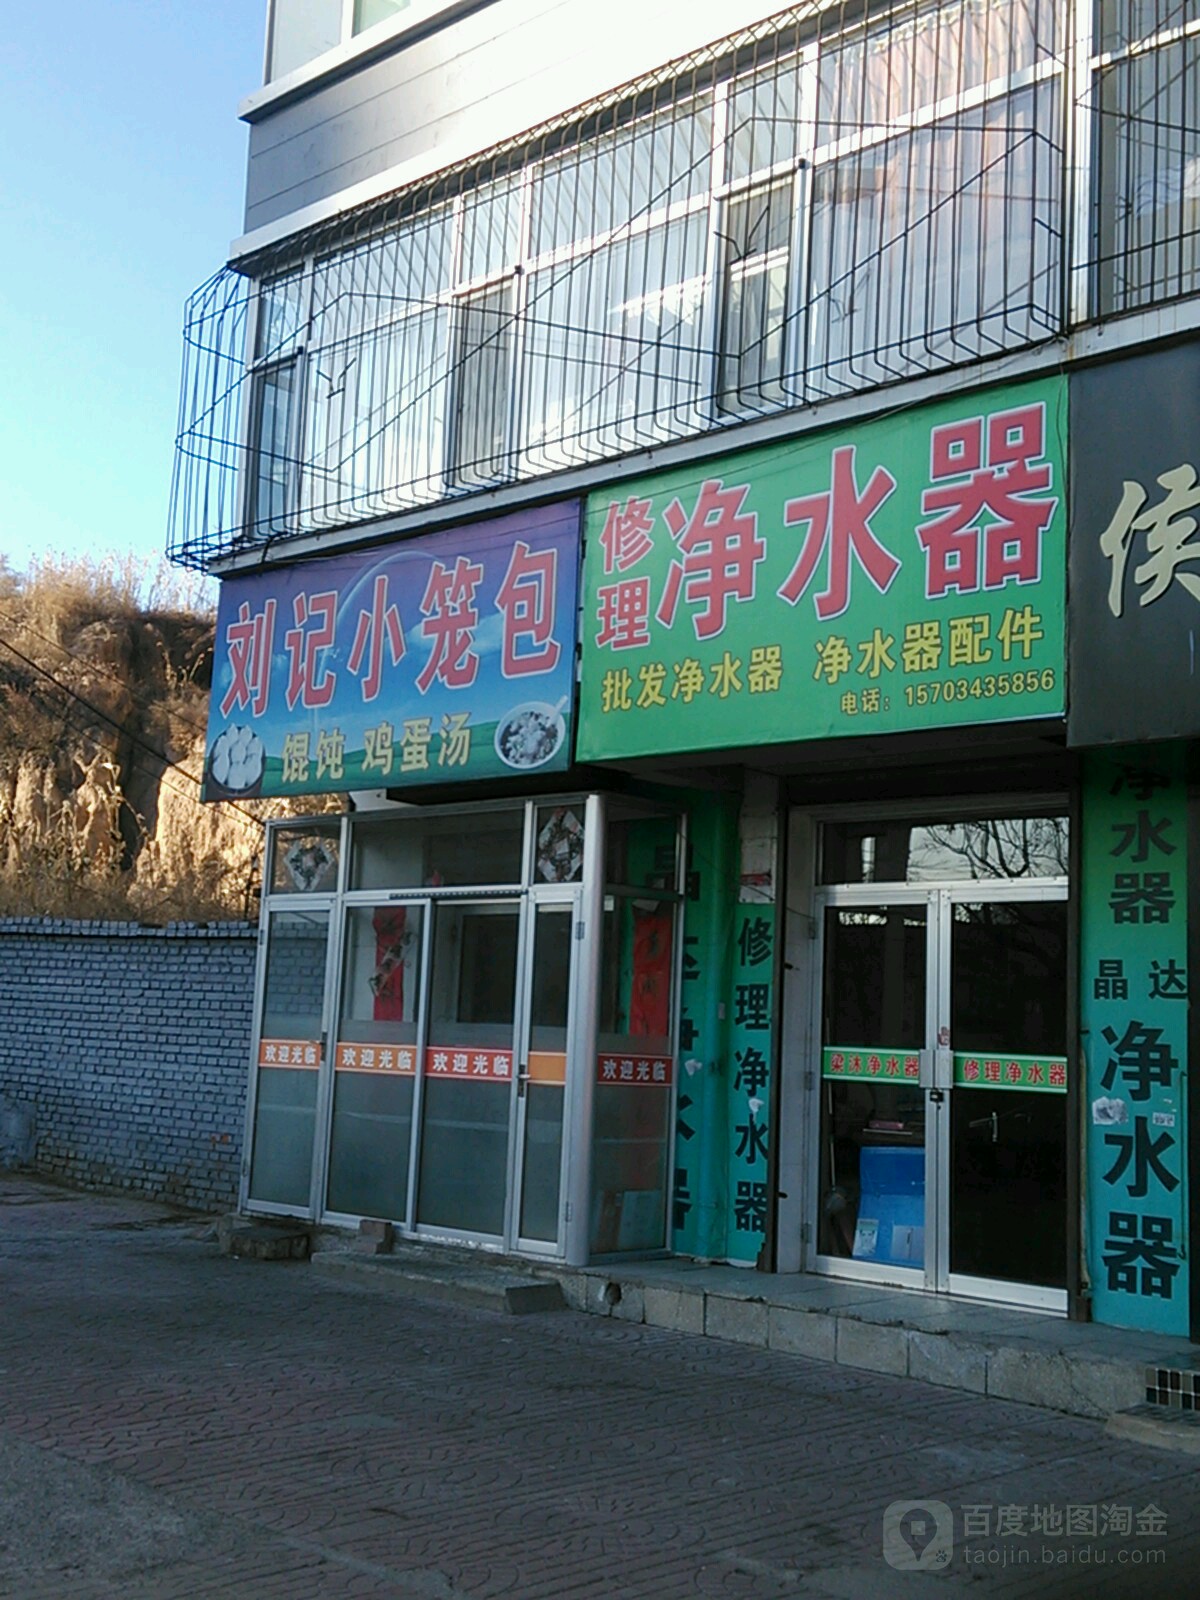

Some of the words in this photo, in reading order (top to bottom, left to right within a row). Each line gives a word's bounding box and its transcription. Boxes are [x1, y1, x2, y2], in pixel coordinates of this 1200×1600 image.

[656, 403, 1059, 640] 净水器
[594, 496, 655, 651] 修理
[220, 542, 561, 718] 刘记小笼包
[602, 645, 784, 713] 批发净水器
[813, 605, 1044, 685] 净水器配件
[905, 669, 1056, 707] 15703435856
[281, 727, 345, 783] 馄饨
[360, 711, 472, 776] 鸡蛋汤
[265, 1045, 318, 1065] 欢迎光临
[342, 1048, 413, 1071] 欢迎光临
[433, 1052, 510, 1078] 欢迎光临
[603, 1059, 666, 1082] 欢迎光临
[733, 916, 773, 1233] 修理净水器
[963, 1059, 1067, 1087] 修理净水器
[1100, 1019, 1181, 1300] 净水器
